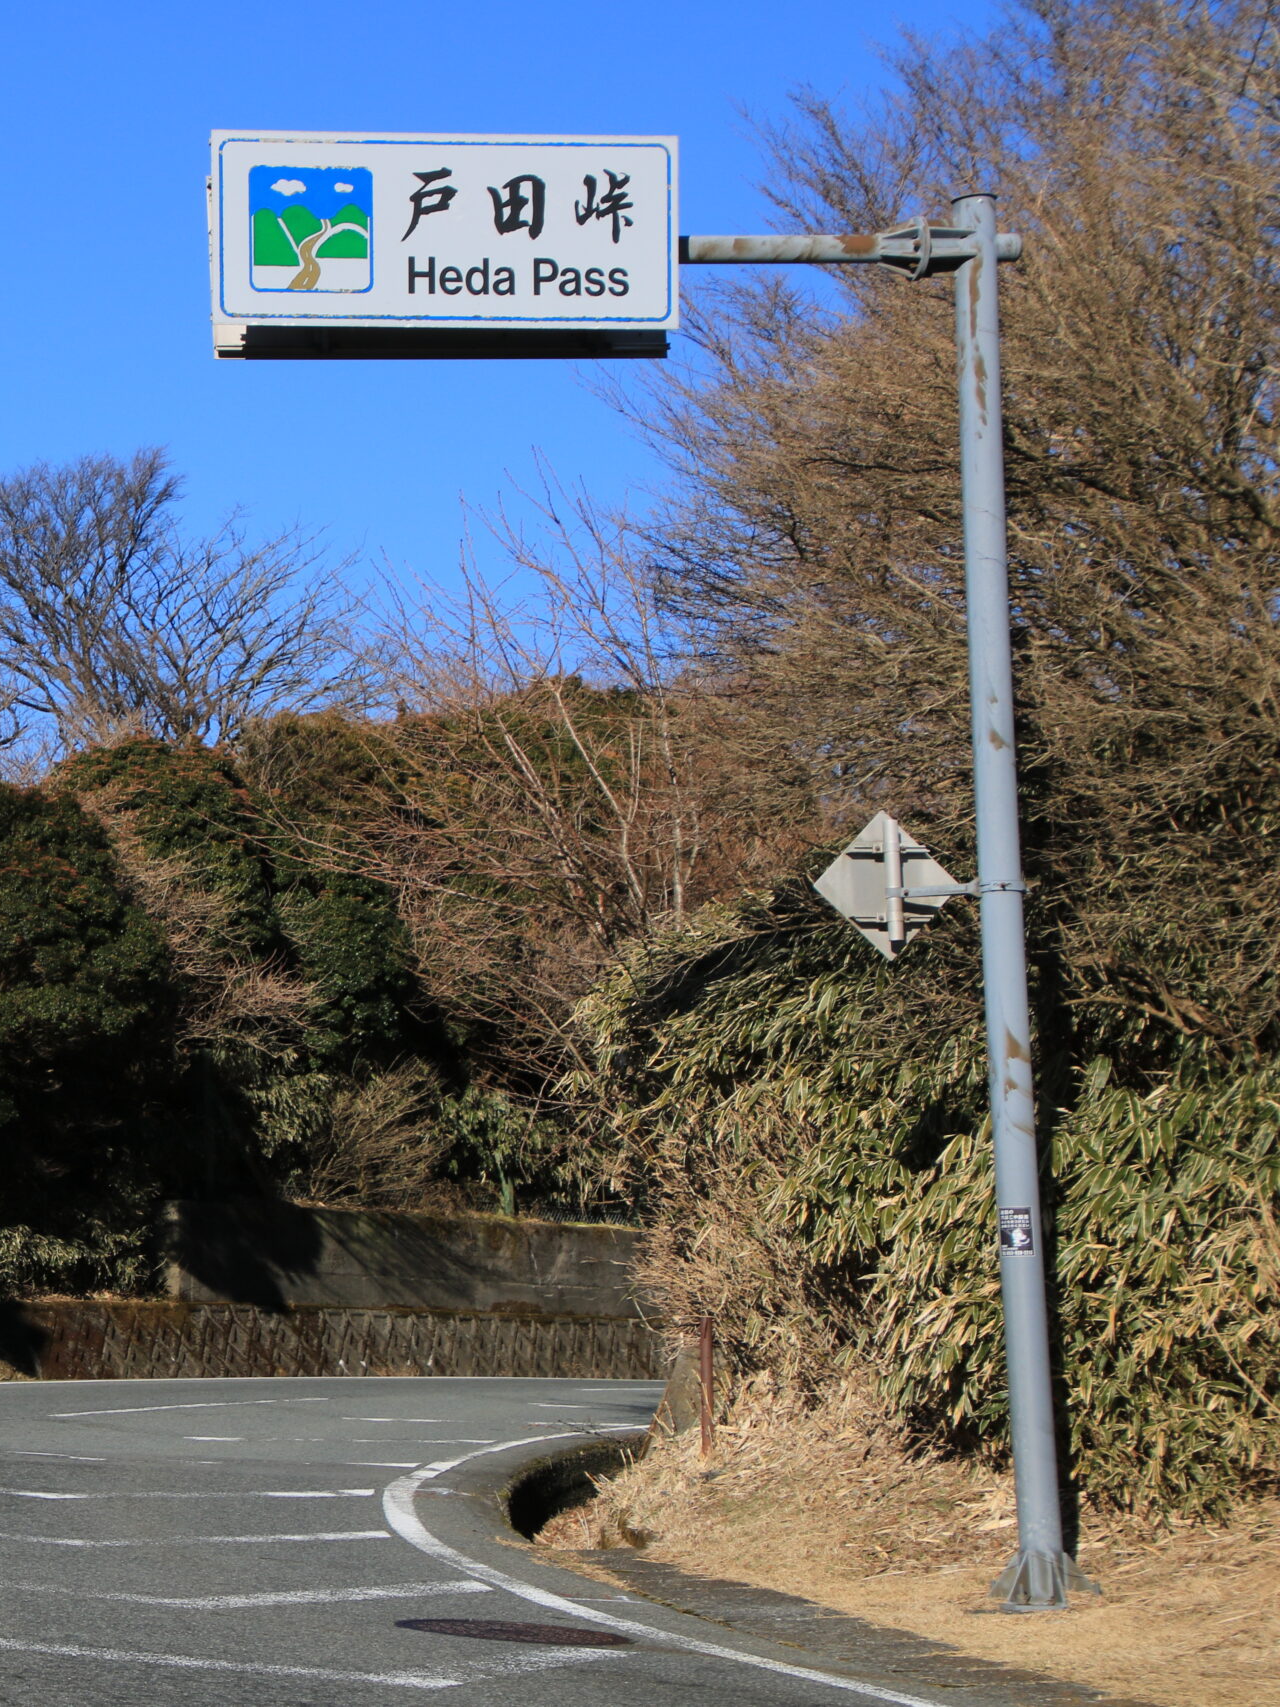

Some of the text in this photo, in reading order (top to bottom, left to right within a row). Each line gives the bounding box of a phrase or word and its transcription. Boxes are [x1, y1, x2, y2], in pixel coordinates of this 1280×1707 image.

[401, 167, 634, 244] 戸田峠
[408, 256, 630, 297] Heda Pass
